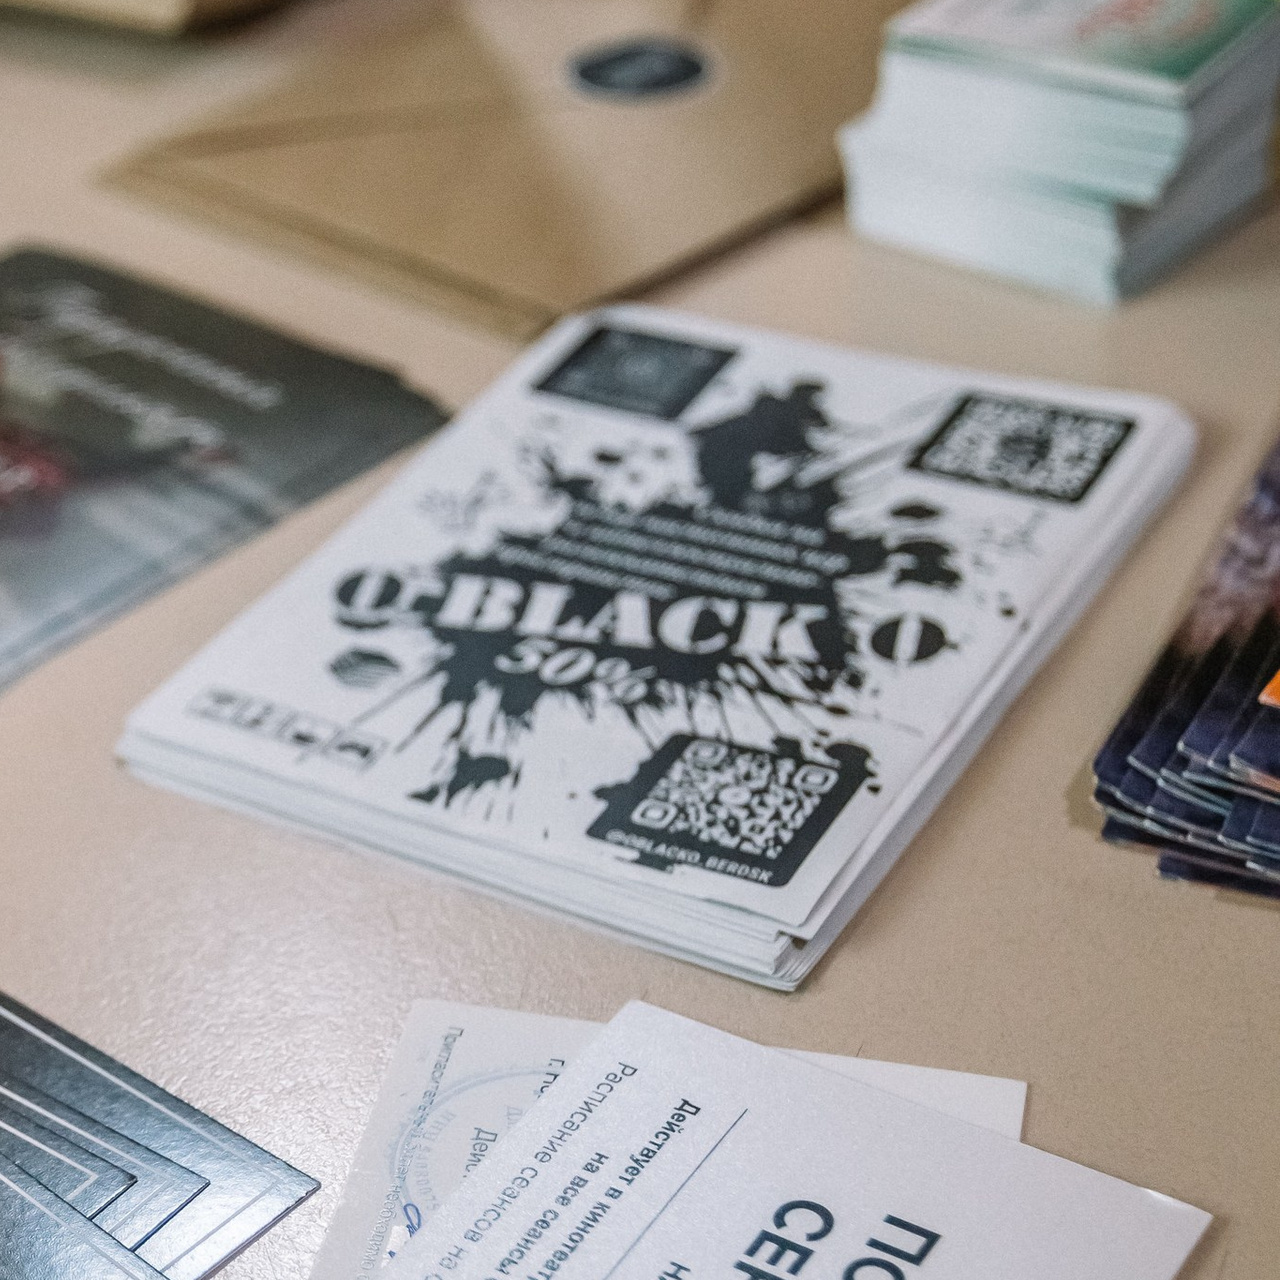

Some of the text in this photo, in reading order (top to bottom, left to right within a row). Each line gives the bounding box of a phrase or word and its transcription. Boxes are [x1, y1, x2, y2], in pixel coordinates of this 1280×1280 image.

[492, 635, 664, 703] 50%
[533, 1061, 639, 1164] Расписание
[619, 1098, 701, 1185] Действует
[557, 1175, 589, 1208] все
[582, 1151, 609, 1175] на
[604, 1186, 624, 1201] в
[462, 1165, 540, 1244] сеансов
[438, 1244, 465, 1272] на
[496, 1208, 560, 1276] сеансы
